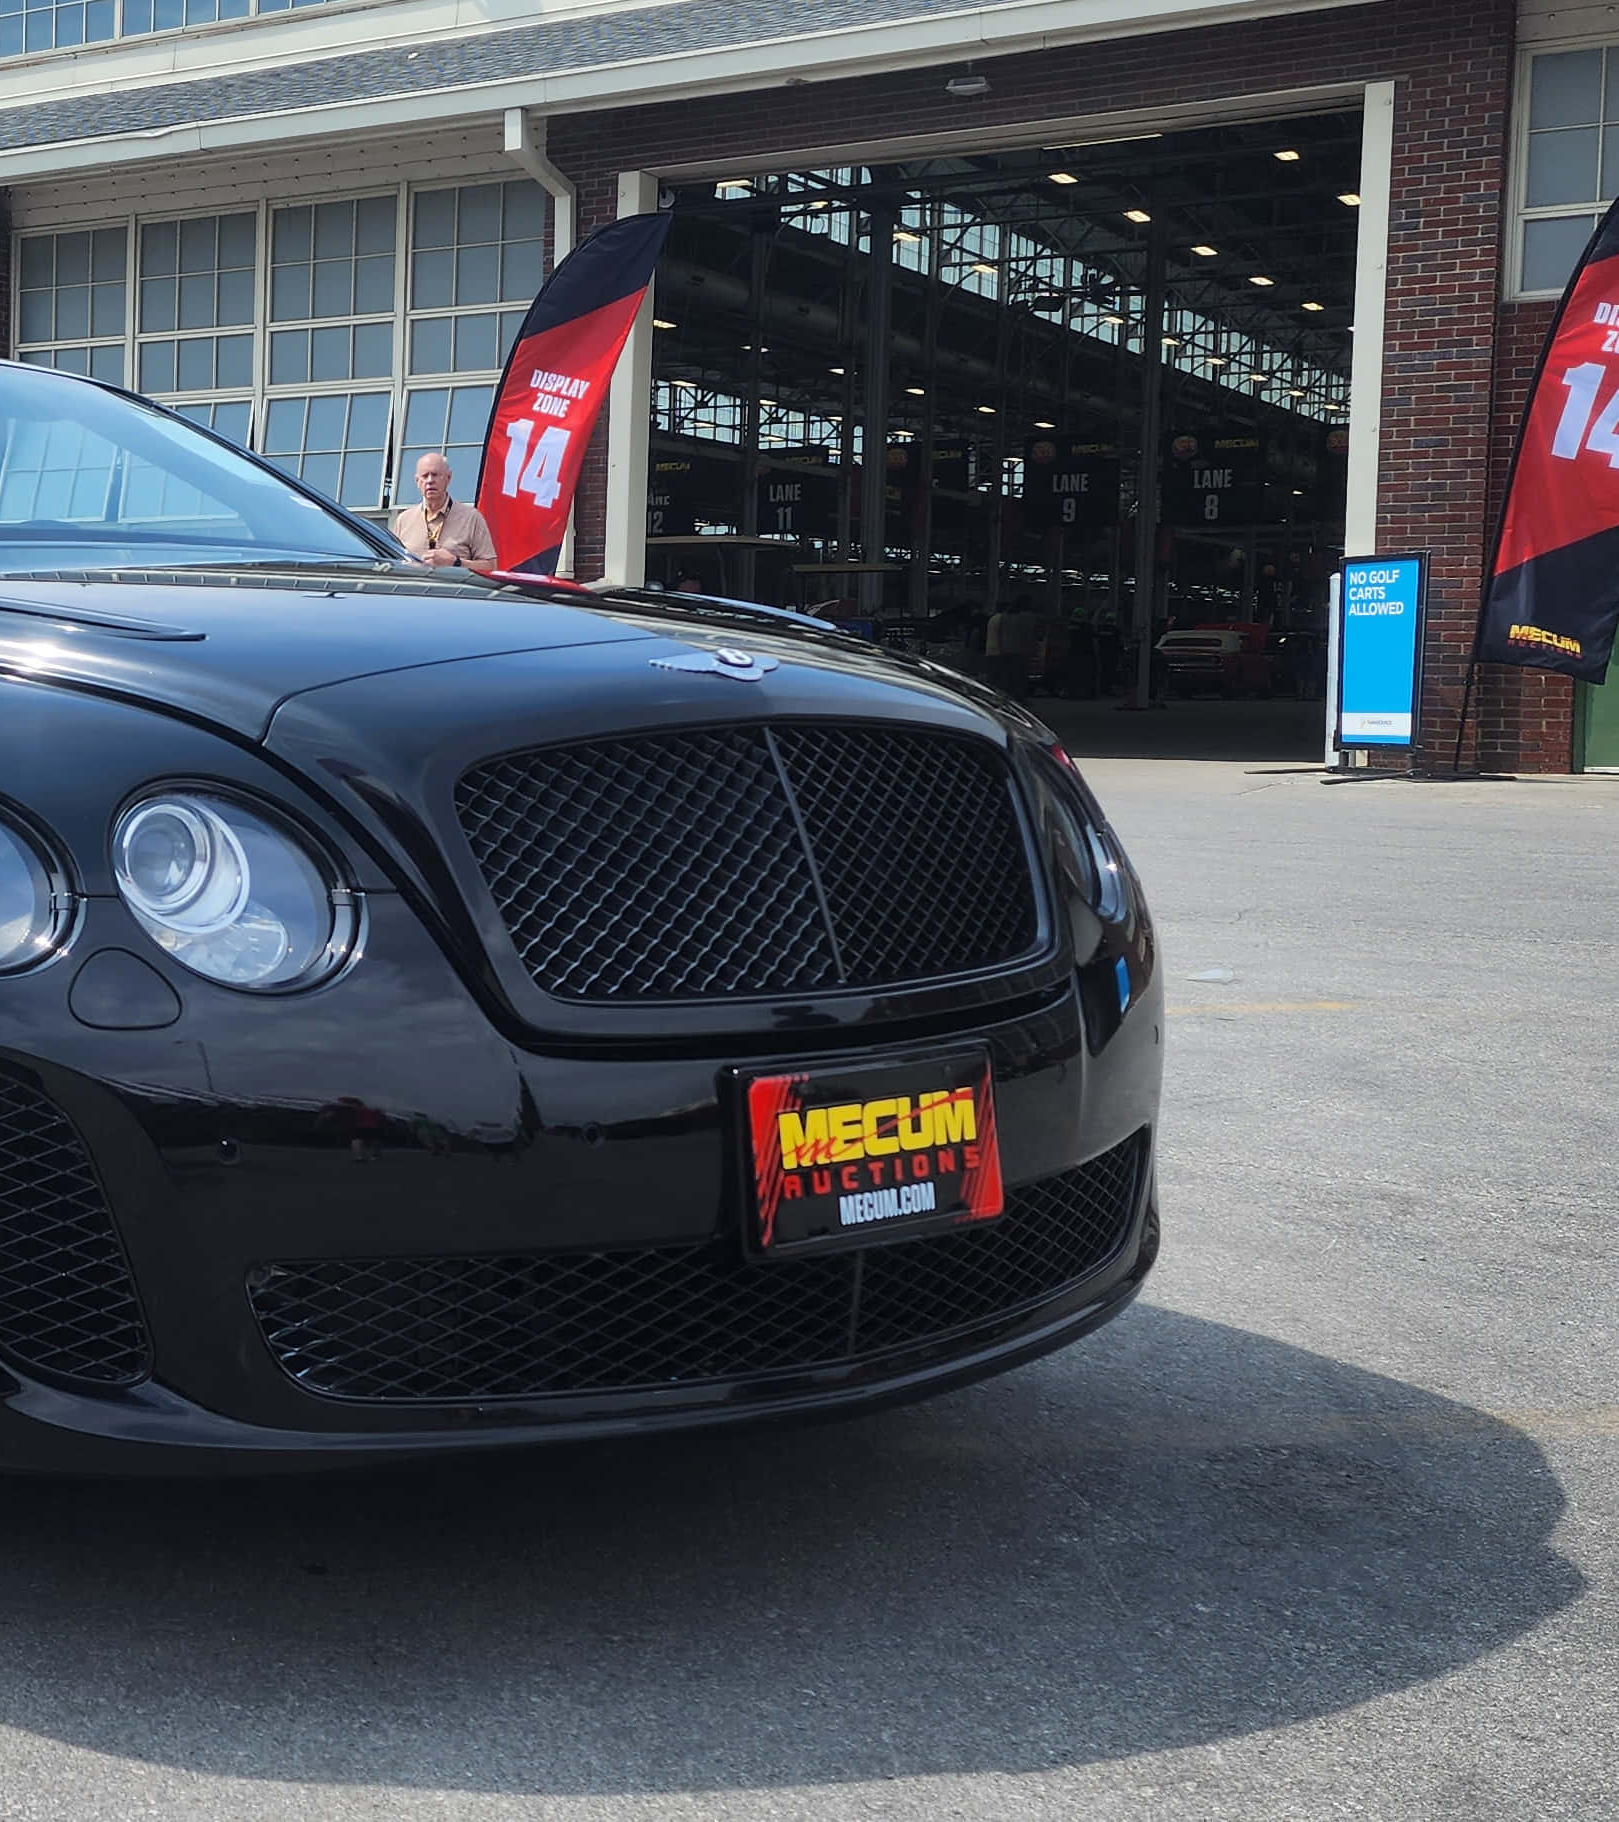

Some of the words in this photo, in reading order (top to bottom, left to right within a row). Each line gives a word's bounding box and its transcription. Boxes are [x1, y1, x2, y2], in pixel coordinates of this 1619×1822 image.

[530, 369, 590, 399] DISPLAY
[532, 392, 571, 418] ZONE
[502, 418, 572, 509] 14
[1052, 473, 1090, 493] LANE
[1193, 469, 1234, 489] LANE
[769, 483, 802, 502] LANE
[776, 506, 793, 531] 11
[1061, 497, 1077, 523] 9
[1204, 494, 1220, 520] 8
[1349, 571, 1367, 585] NO
[1369, 570, 1400, 584] GOLF
[1349, 586, 1386, 600] CARTS
[1348, 601, 1404, 616] ALLOWED
[1509, 624, 1581, 654] MECUM
[778, 1087, 977, 1170] MECUM
[783, 1145, 982, 1199] AUCTIONS
[839, 1182, 936, 1226] MECUM.COM
